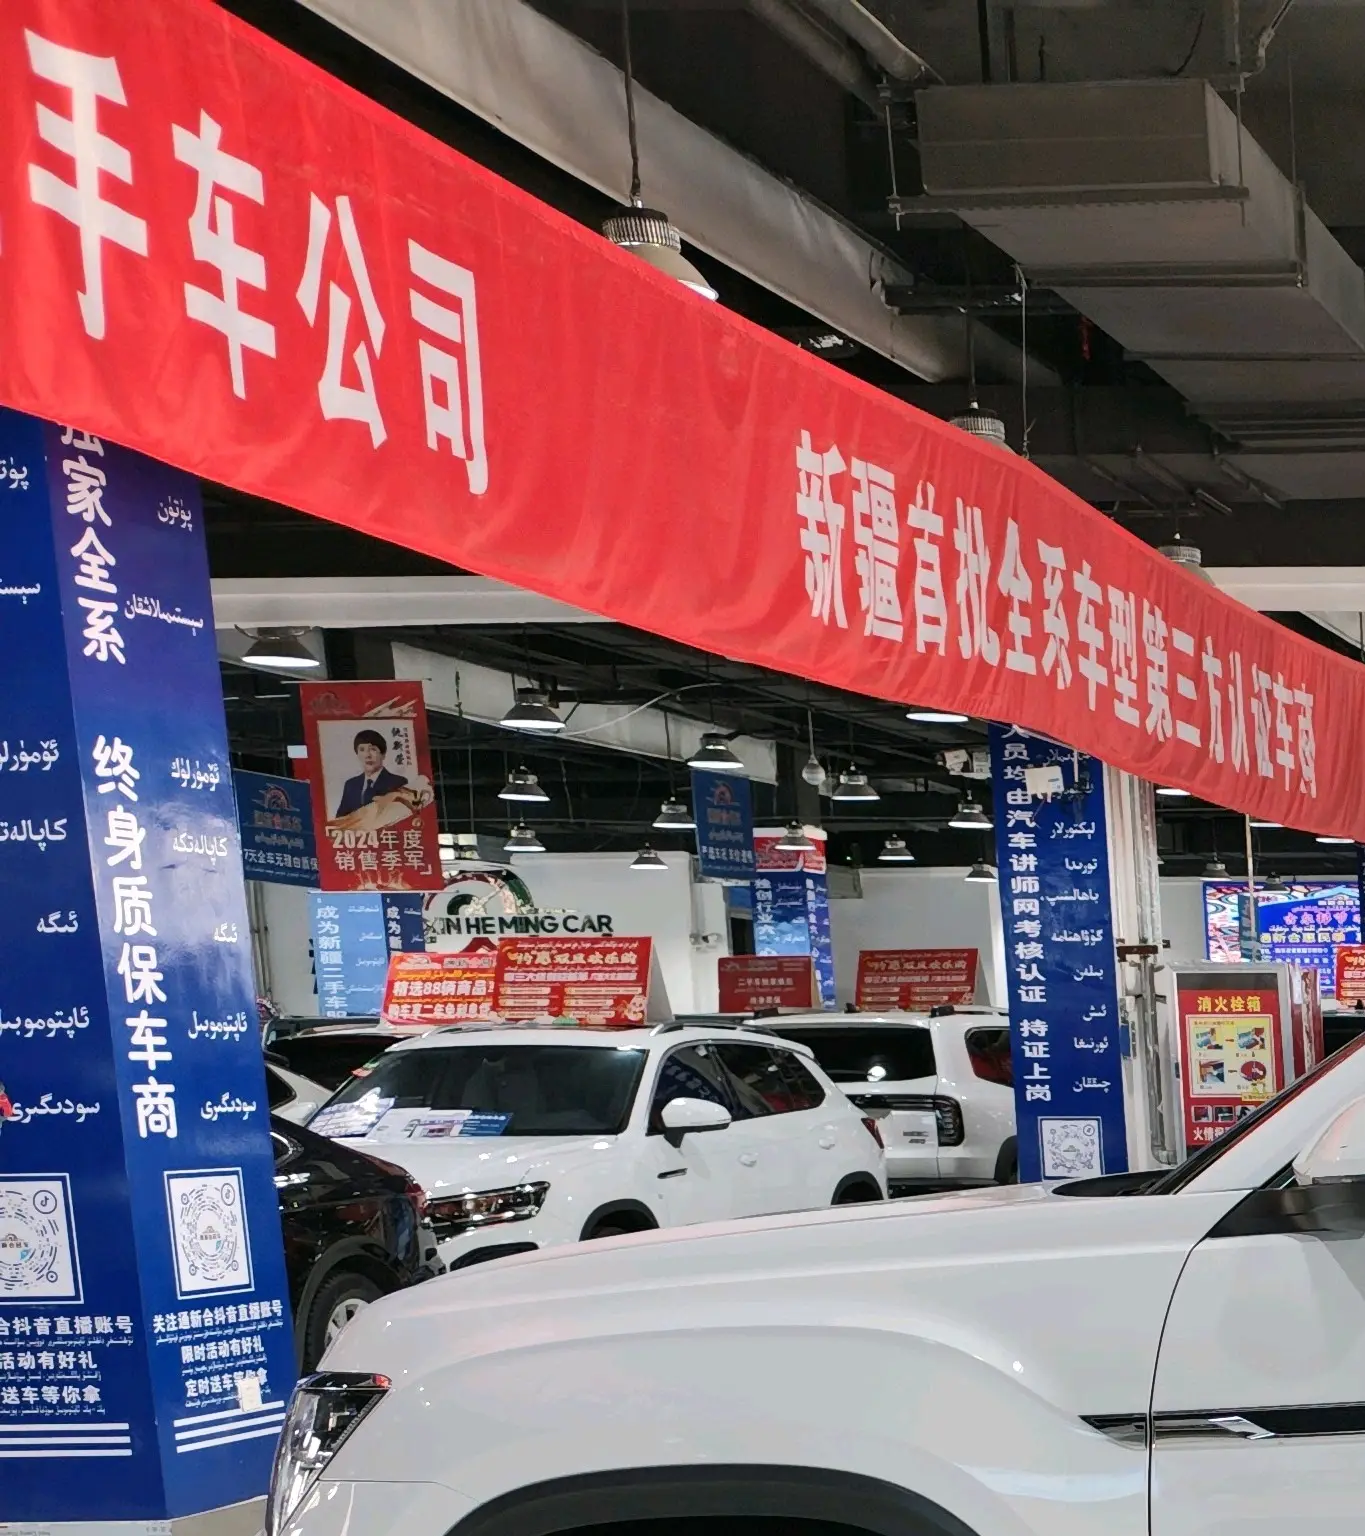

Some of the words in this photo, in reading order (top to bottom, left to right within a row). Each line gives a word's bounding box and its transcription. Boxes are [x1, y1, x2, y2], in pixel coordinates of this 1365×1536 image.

[25, 28, 487, 496] 手车公司
[796, 429, 1317, 799] 新疆首批全系车型第三方认证车商
[332, 830, 423, 849] 2024年度
[335, 851, 425, 870] 销售季军
[466, 917, 496, 934] HE
[499, 916, 559, 934] MING
[563, 915, 613, 933] CAR
[92, 735, 178, 1139] 终身质保车商
[1197, 996, 1261, 1012] 消火栓箱
[182, 1335, 264, 1364] 限时活动有好礼
[1, 1385, 101, 1404] 送车等你拿
